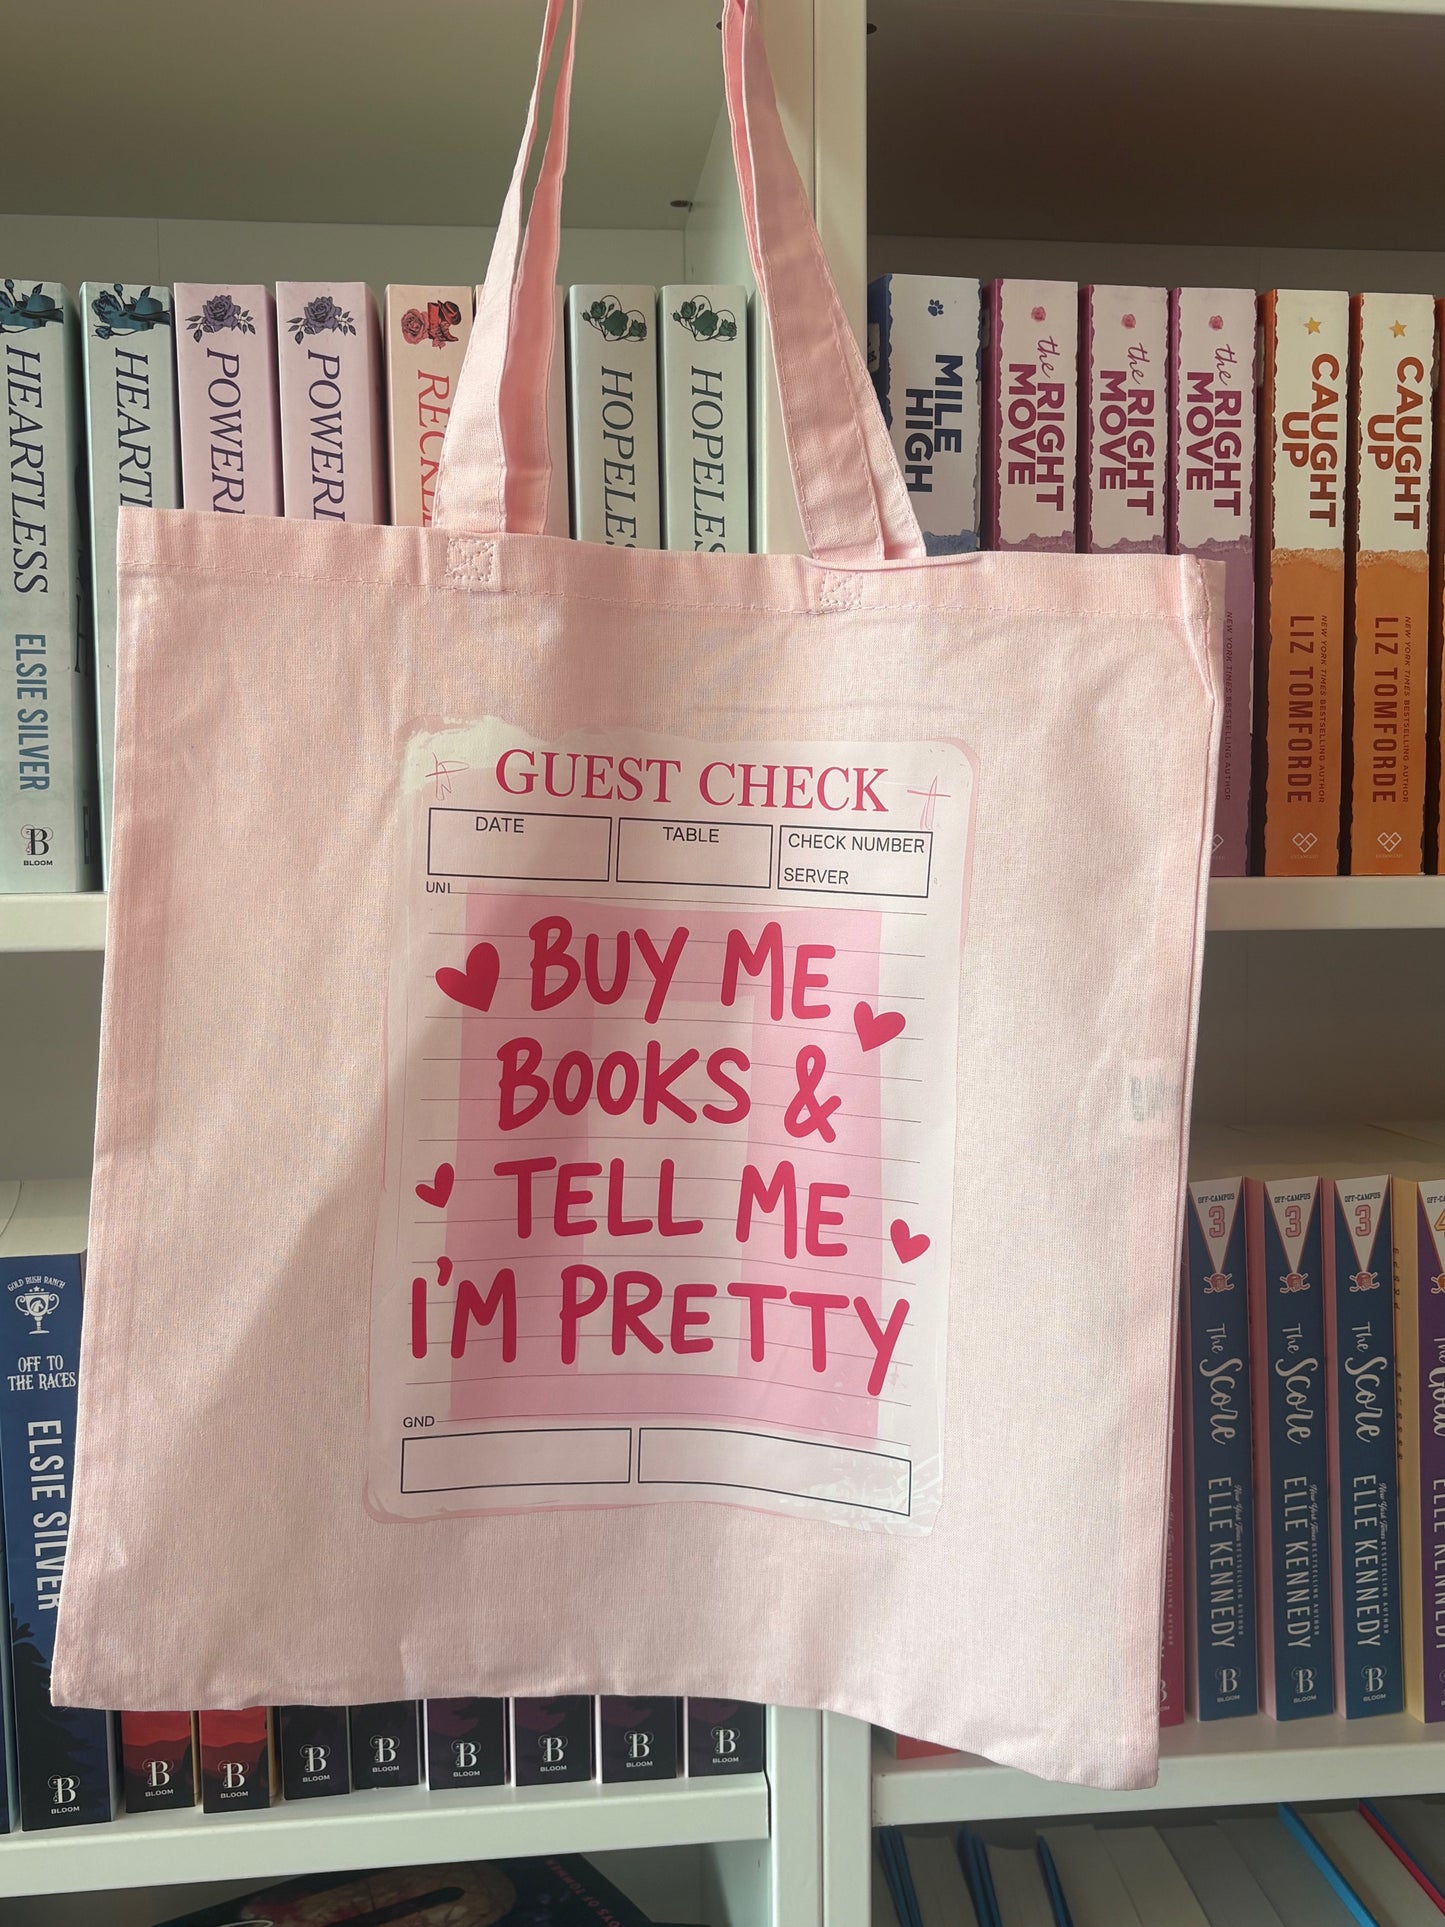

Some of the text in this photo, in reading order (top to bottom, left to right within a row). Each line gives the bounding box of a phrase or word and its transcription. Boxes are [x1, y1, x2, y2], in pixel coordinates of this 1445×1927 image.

[933, 353, 964, 454] MILE
[1007, 364, 1036, 485] MOVE
[1035, 335, 1065, 511] the RIGHT
[1099, 371, 1127, 490] MOVE
[1126, 342, 1155, 516] the RIGHT
[1186, 371, 1213, 491] MOVE
[1213, 343, 1242, 516] the RIGHT
[904, 389, 933, 493] HIGH
[1281, 411, 1310, 468] UP
[1309, 353, 1339, 528] CAUGHT
[1367, 414, 1395, 471] UP
[1394, 356, 1425, 530] CAUGHT
[5, 344, 49, 594] HEARTLESS
[601, 365, 637, 549] HOPELE
[15, 633, 50, 791] ELSIE SILVER
[1287, 615, 1315, 803] LIZ TOMFORDE
[1372, 616, 1399, 803] LIZ TOMFORDE
[495, 748, 889, 813] GUEST CHECK
[475, 816, 525, 834] DATE
[662, 826, 720, 843] TABLE
[23, 826, 51, 855] B
[788, 834, 925, 854] CHECK NUMBER
[425, 881, 451, 894] UNI
[783, 867, 850, 885] SERVER
[528, 916, 836, 1024] BUY ME
[497, 1037, 843, 1143] BOOKS &
[493, 1156, 851, 1260] TELL ME
[1197, 1193, 1235, 1204] OFF-CAMPUS
[1274, 1192, 1311, 1203] OFF-CAMPUS
[1344, 1191, 1381, 1203] OFF-CAMPUS
[1208, 1205, 1226, 1238] 3
[1284, 1204, 1302, 1238] 3
[1355, 1204, 1372, 1237] 3
[7, 1279, 24, 1292] GOLD
[43, 1275, 66, 1289] RANCH
[411, 1256, 910, 1397] I'M PRETTY
[1206, 1322, 1228, 1354] The
[1282, 1322, 1304, 1354] The
[1351, 1321, 1373, 1353] The
[18, 1354, 64, 1373] OFF TO
[7, 1371, 77, 1391] THE RACES
[1199, 1357, 1243, 1445] Score
[1275, 1357, 1319, 1445] Score
[1344, 1356, 1388, 1444] Score
[402, 1415, 435, 1428] GND
[28, 1420, 68, 1611] ELSIE SILVER
[1208, 1476, 1235, 1648] ELLE KENNEDY
[1283, 1476, 1312, 1648] ELLE KENNEDY
[1353, 1474, 1381, 1646] ELLE KENNEDY
[1219, 1667, 1239, 1693] B
[1295, 1667, 1315, 1693] B
[1365, 1667, 1385, 1692] B
[1217, 1694, 1240, 1703] BLOOM
[1293, 1694, 1316, 1703] BLOOM
[1363, 1693, 1386, 1702] BLOOM
[374, 1737, 397, 1763] B
[455, 1741, 478, 1767] B
[542, 1737, 565, 1762] B
[628, 1732, 651, 1758] B
[715, 1728, 737, 1754] B
[304, 1746, 328, 1772] B
[372, 1764, 400, 1773] BLOOM
[539, 1764, 567, 1773] BLOOM
[626, 1760, 653, 1768] BLOOM
[712, 1756, 739, 1764] BLOOM
[147, 1760, 172, 1787] B
[222, 1762, 247, 1788] B
[302, 1773, 330, 1783] BLOOM
[453, 1770, 481, 1778] BLOOM
[52, 1776, 78, 1803] B
[145, 1788, 174, 1798] BLOOM
[220, 1790, 249, 1799] BLOOM
[51, 1805, 80, 1815] BLOOM
